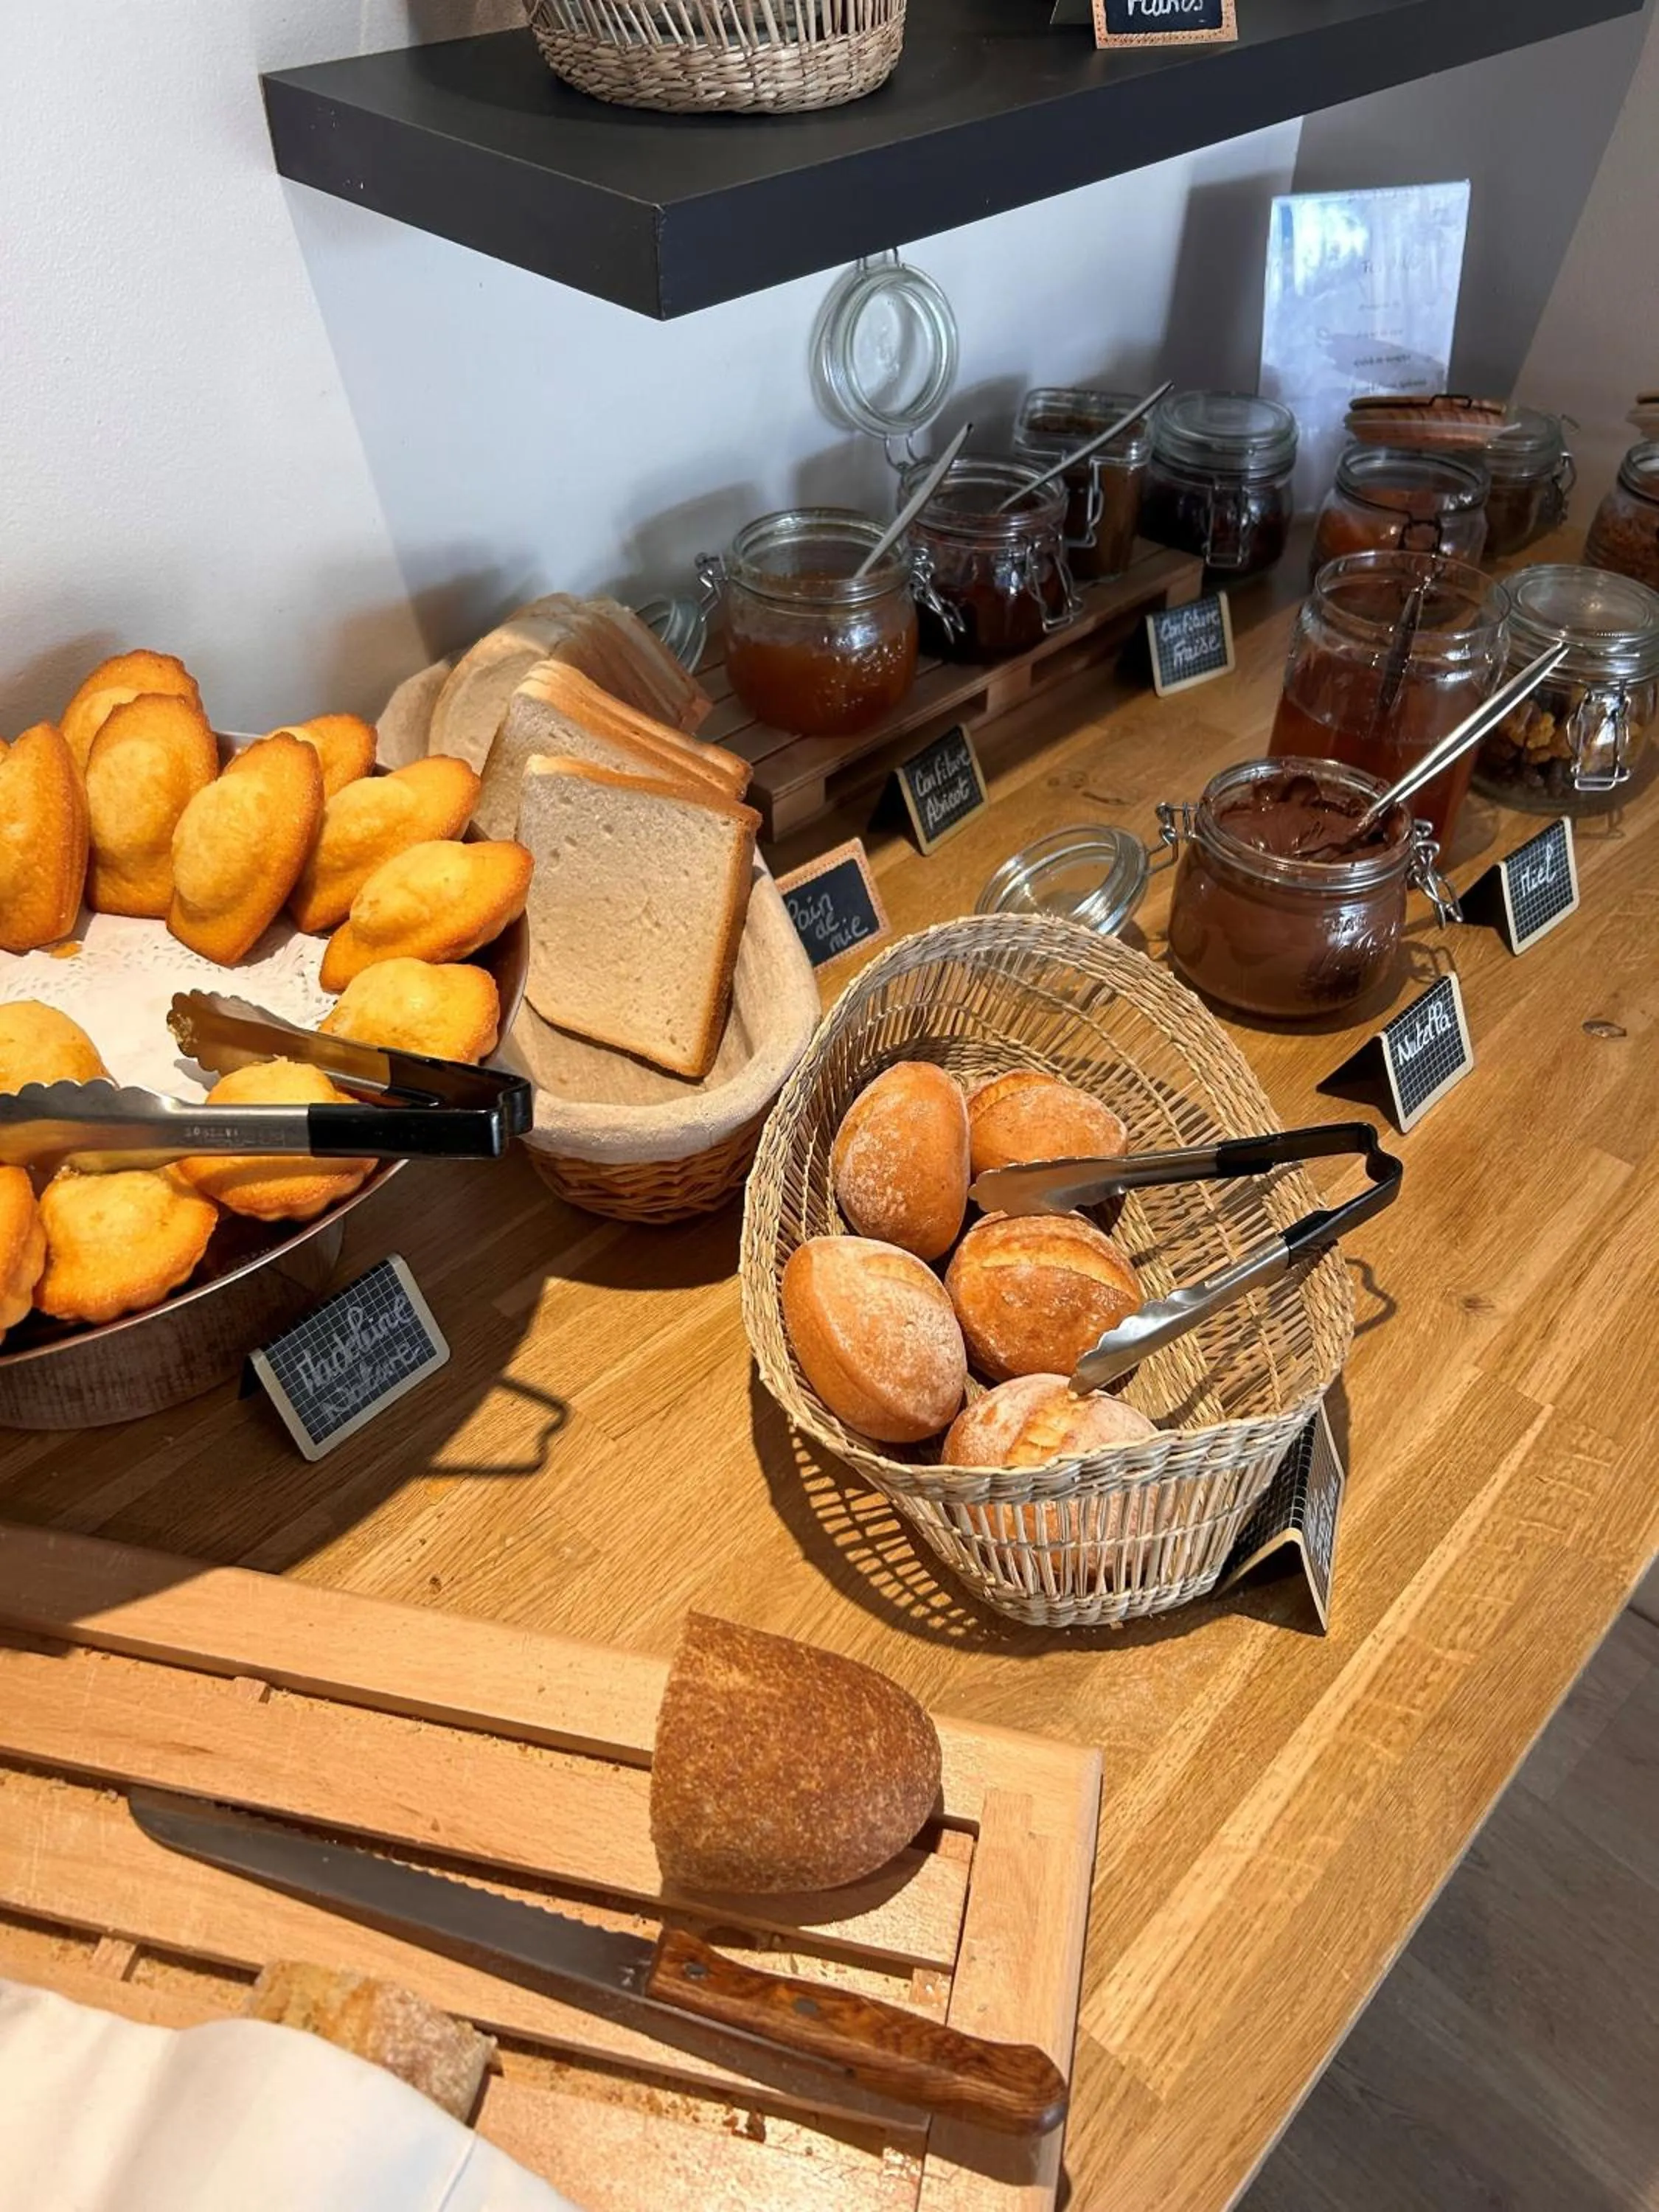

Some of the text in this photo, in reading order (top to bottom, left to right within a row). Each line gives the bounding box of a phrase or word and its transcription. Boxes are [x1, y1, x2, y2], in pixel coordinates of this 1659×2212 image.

[1174, 635, 1221, 671] Fraise
[1521, 843, 1556, 897] Miel
[815, 911, 839, 940] de
[830, 916, 869, 953] mie
[1397, 1001, 1452, 1065] Nutella
